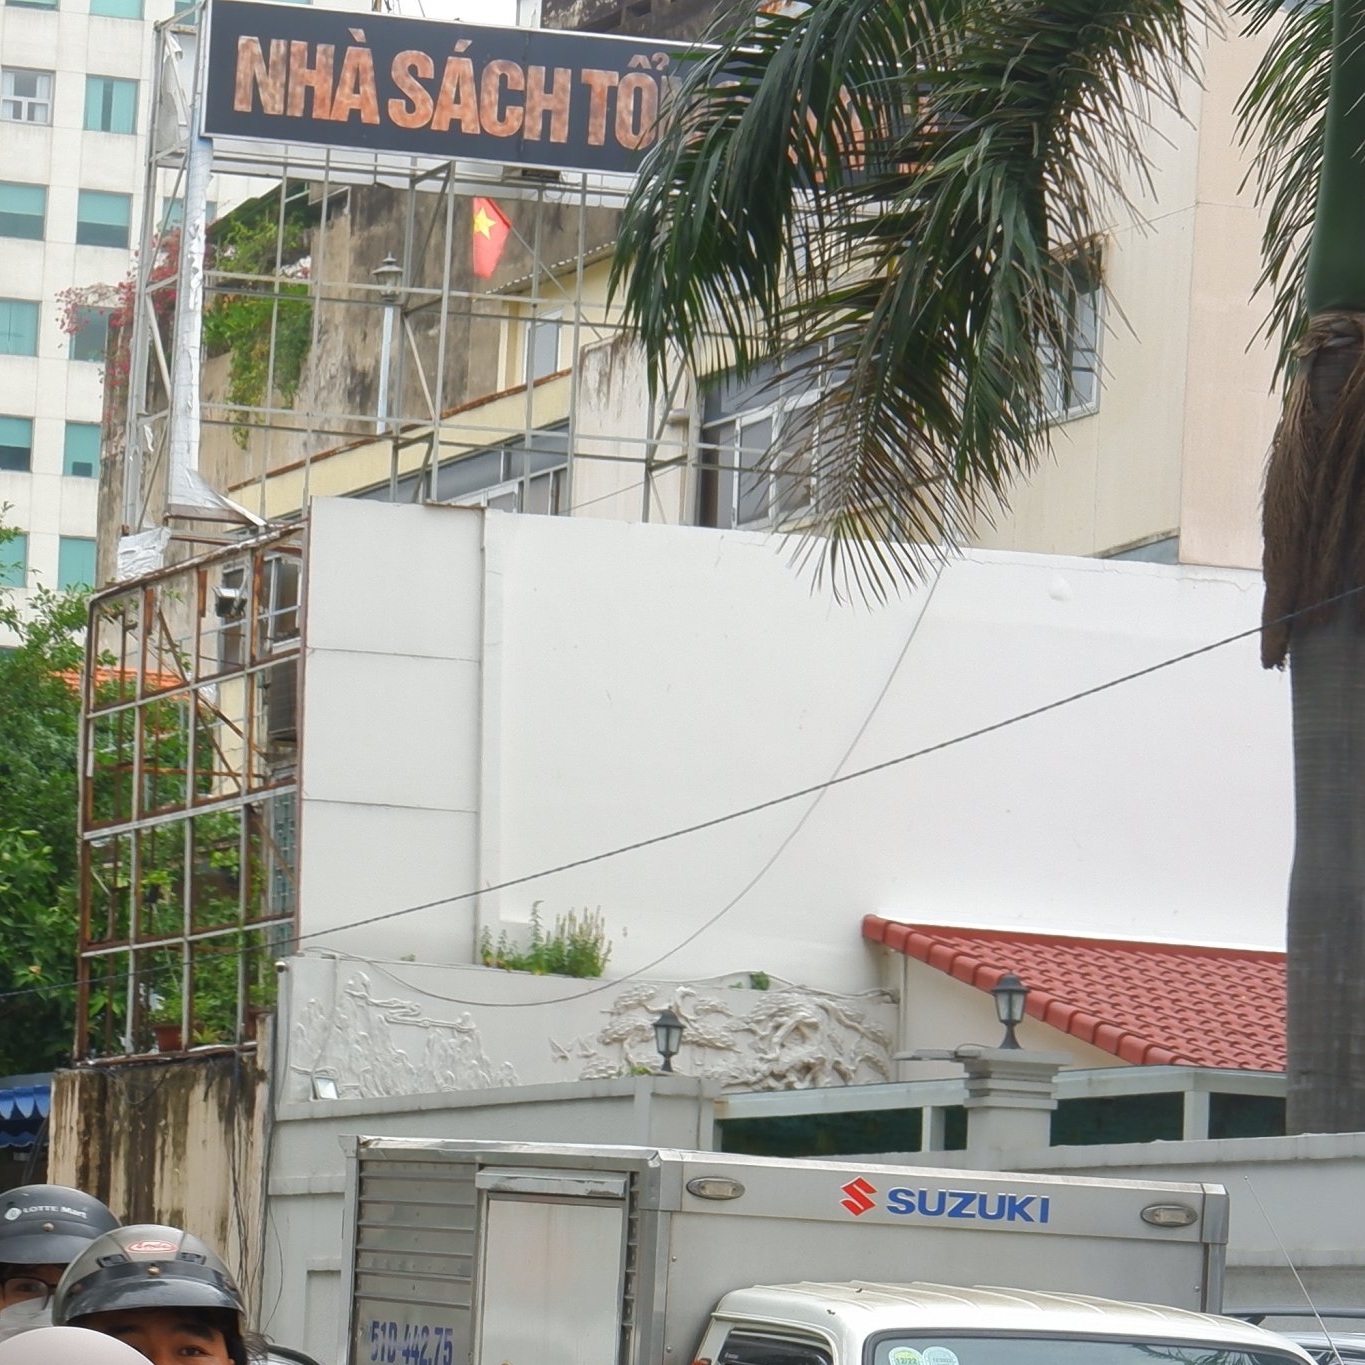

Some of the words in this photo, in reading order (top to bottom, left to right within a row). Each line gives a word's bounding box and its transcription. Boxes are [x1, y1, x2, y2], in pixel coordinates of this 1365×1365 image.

[233, 28, 380, 124] NHÀ
[388, 40, 572, 144] SÁCH
[22, 1205, 59, 1213] LOTTE
[885, 1185, 1051, 1225] SUZUKI
